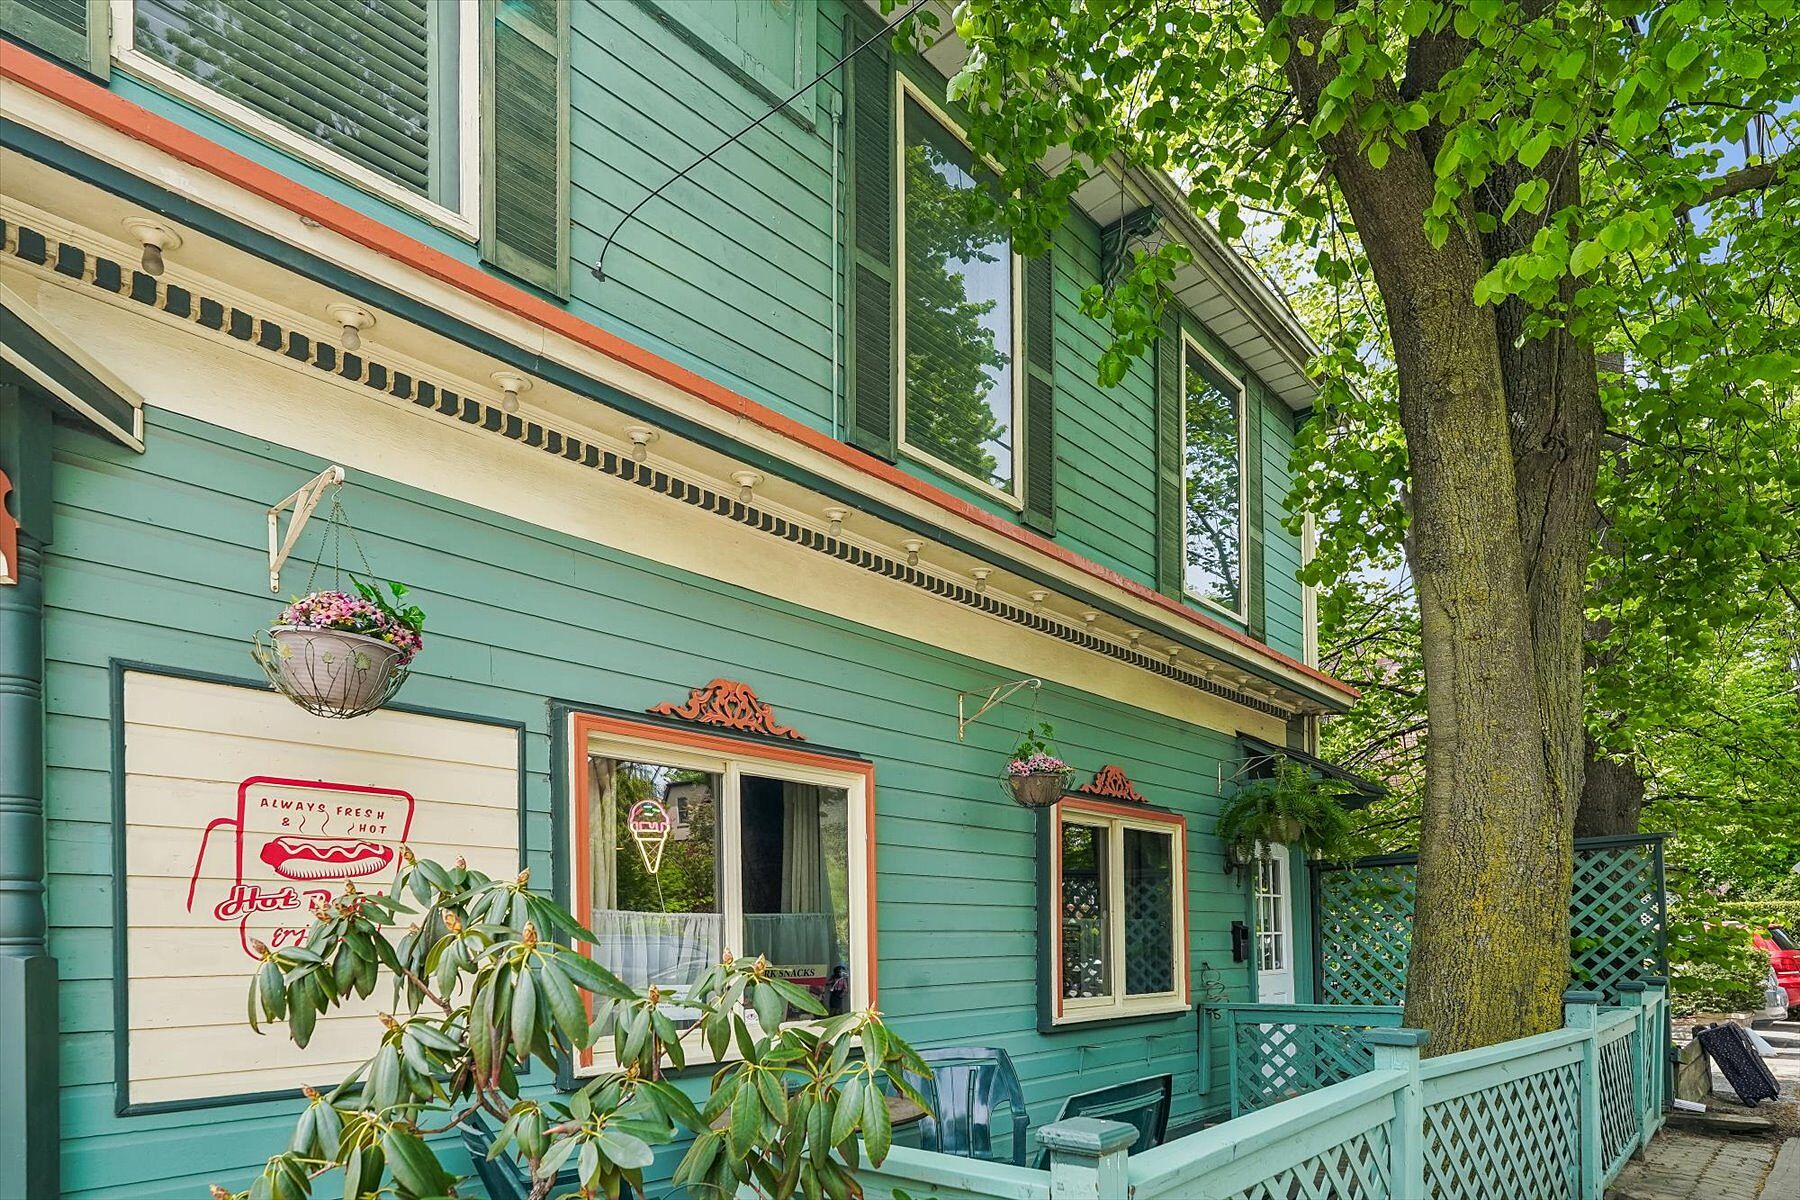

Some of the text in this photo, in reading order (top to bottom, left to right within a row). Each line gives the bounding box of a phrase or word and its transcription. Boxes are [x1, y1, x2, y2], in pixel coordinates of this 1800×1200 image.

[260, 798, 385, 820] ALWAYS FRESH
[281, 817, 387, 834] & HOT
[214, 885, 300, 921] Hot
[779, 968, 815, 978] SNACKS
